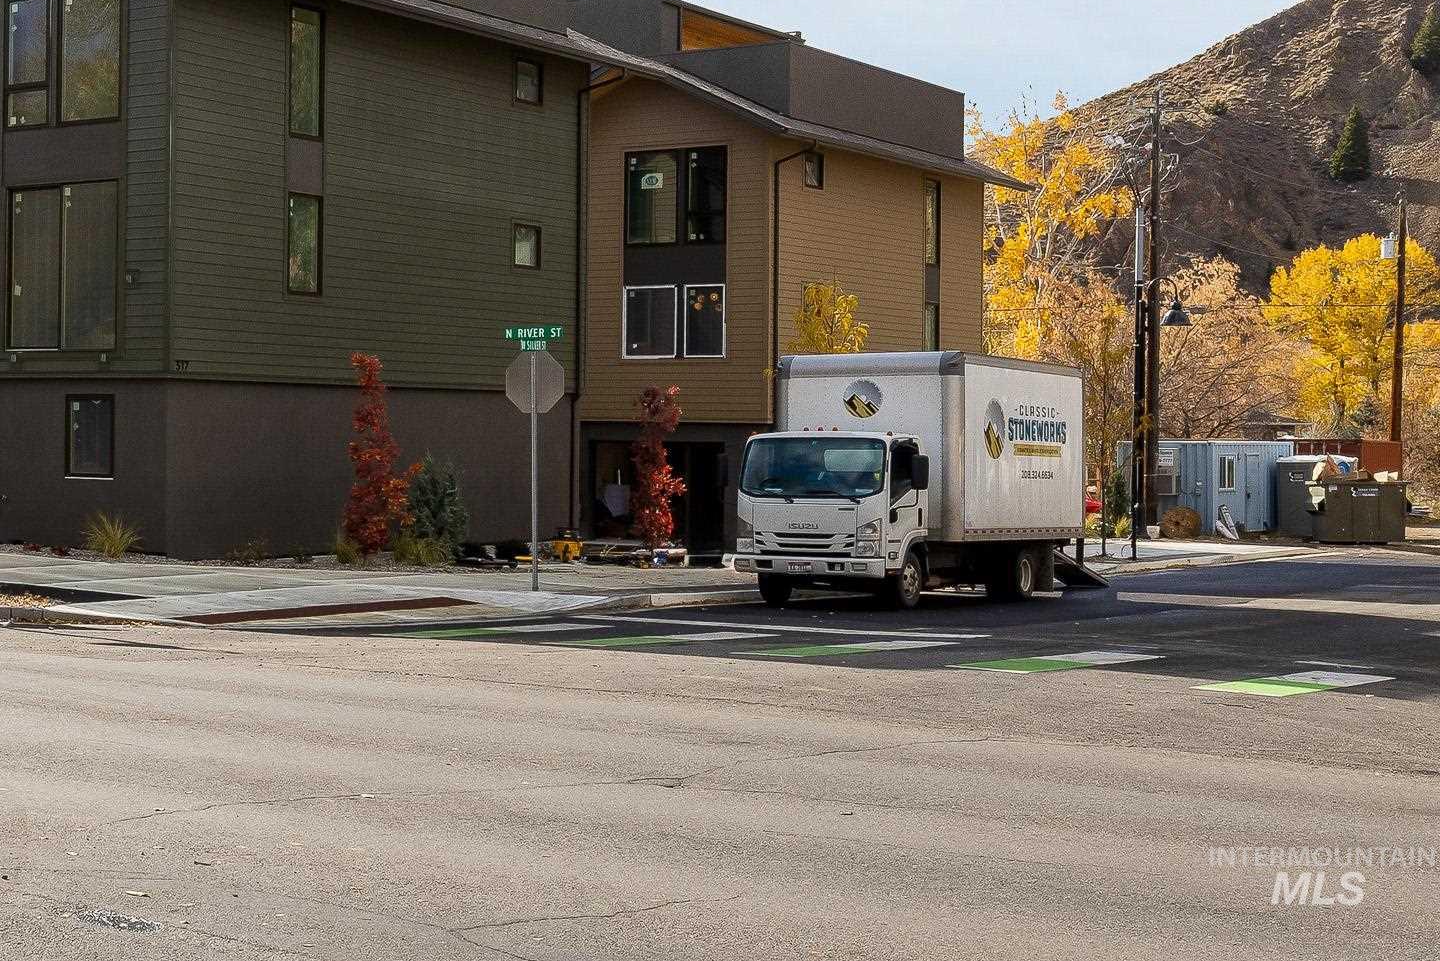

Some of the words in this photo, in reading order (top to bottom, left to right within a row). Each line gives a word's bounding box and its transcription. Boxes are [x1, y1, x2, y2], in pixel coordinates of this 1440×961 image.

[505, 328, 512, 339] N
[517, 328, 545, 338] RIVER
[550, 327, 562, 338] ST
[1019, 404, 1056, 419] CLASSIC
[1007, 416, 1067, 445] STONEWORKS
[788, 522, 819, 530] ISUZU
